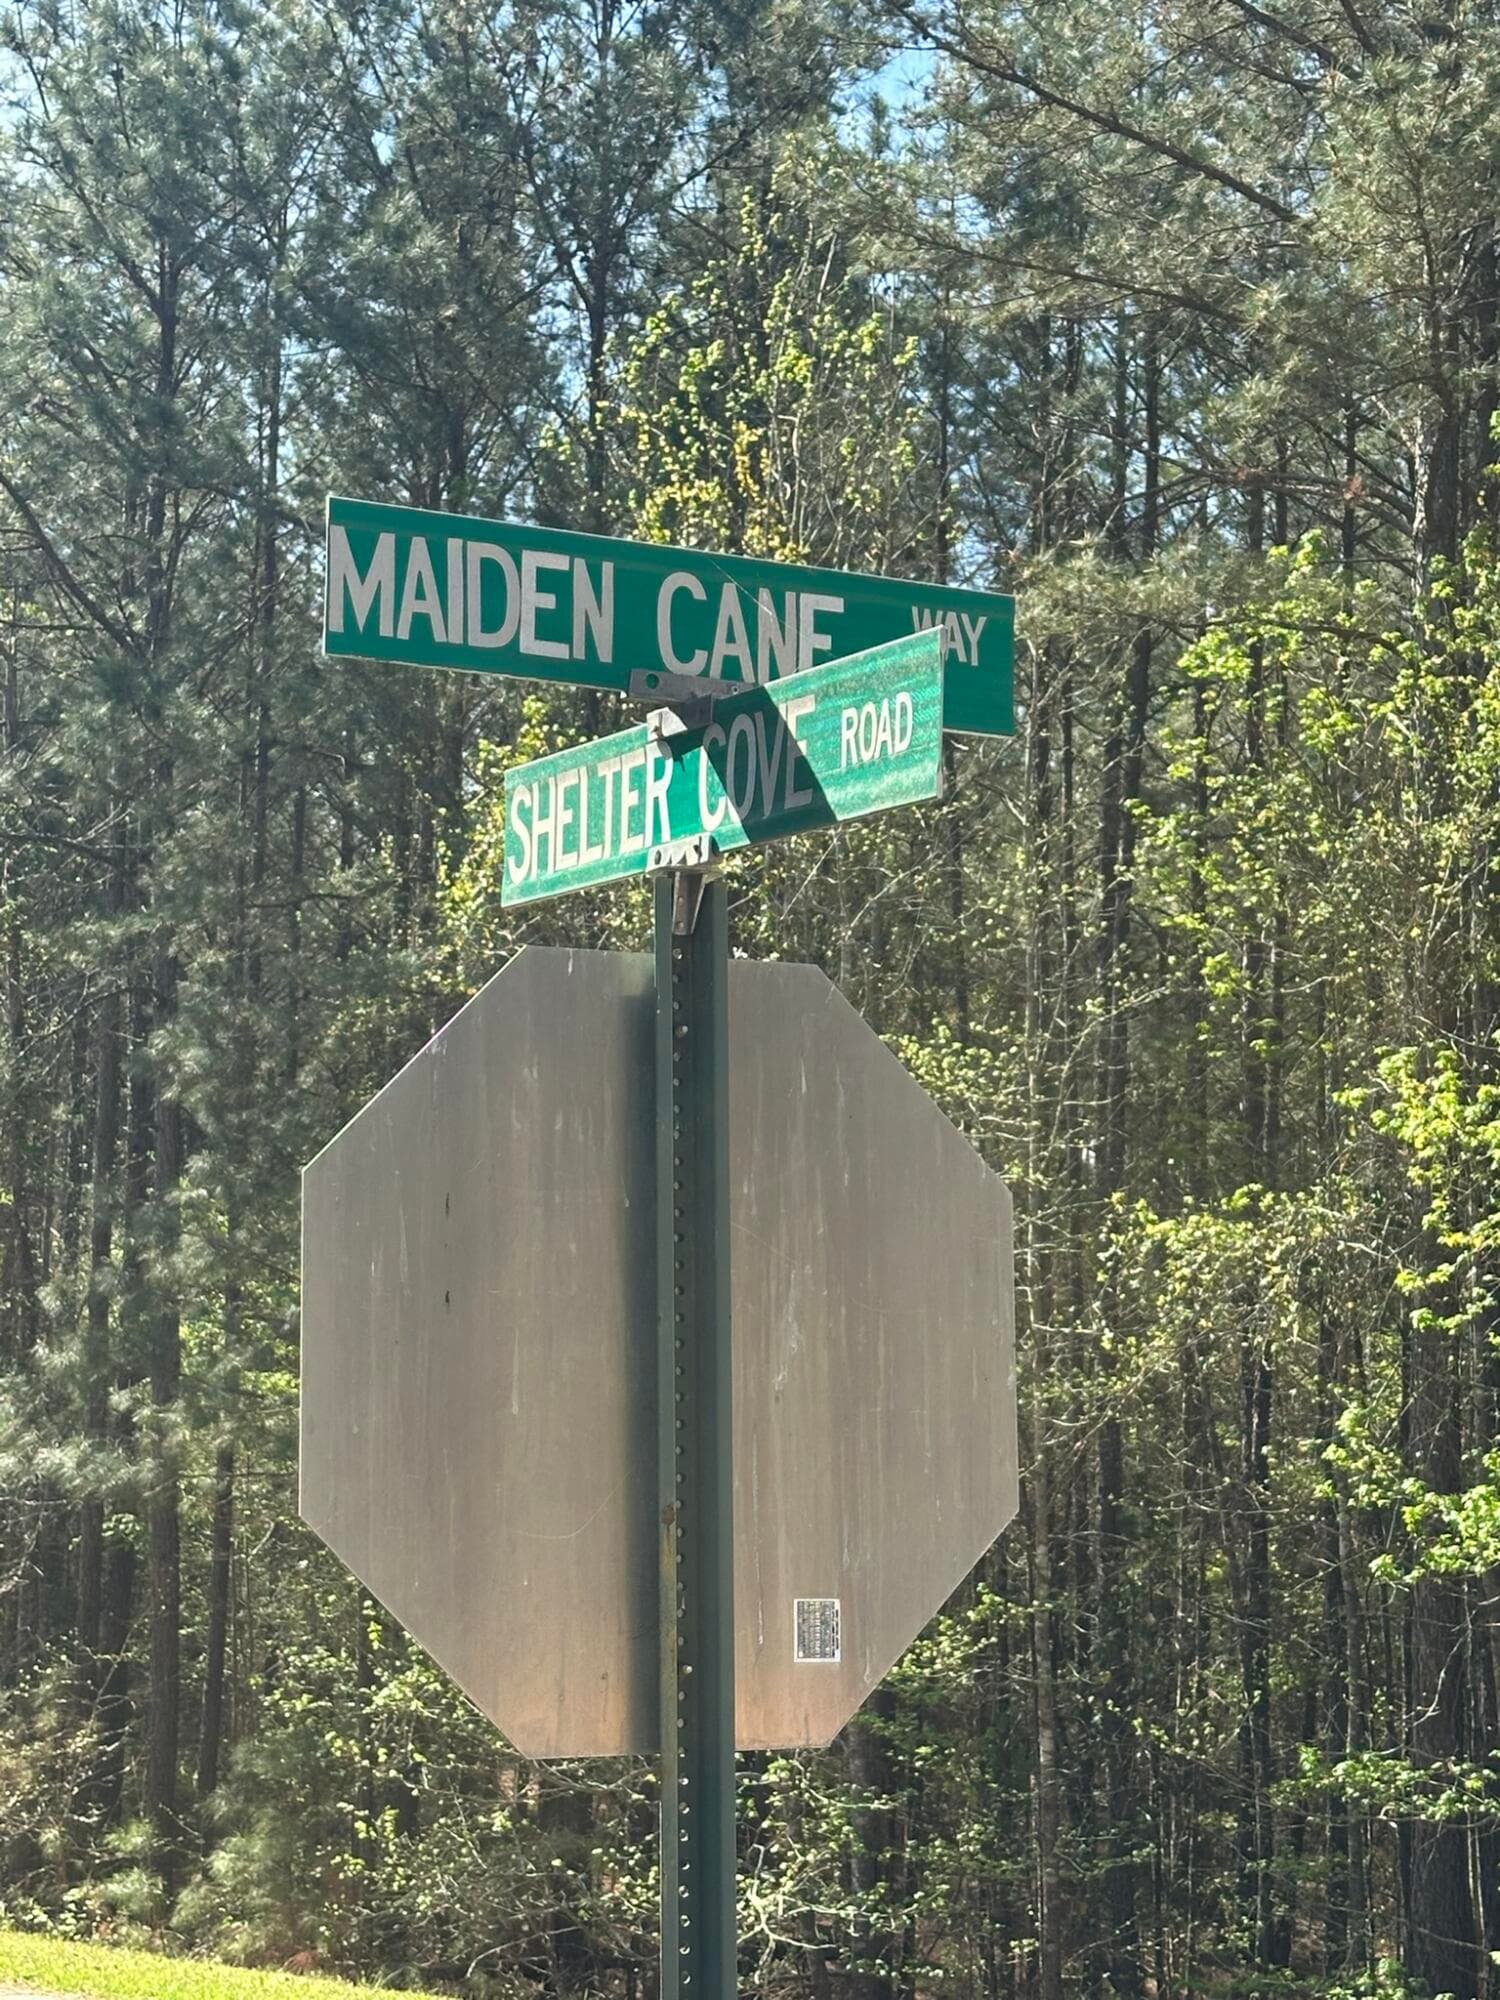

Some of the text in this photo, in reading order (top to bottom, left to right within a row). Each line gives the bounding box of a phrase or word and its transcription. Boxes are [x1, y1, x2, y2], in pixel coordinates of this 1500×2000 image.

[328, 525, 614, 663] MAIDEN
[657, 571, 844, 686] CANE
[507, 692, 914, 885] SHELTER COVE ROAD
